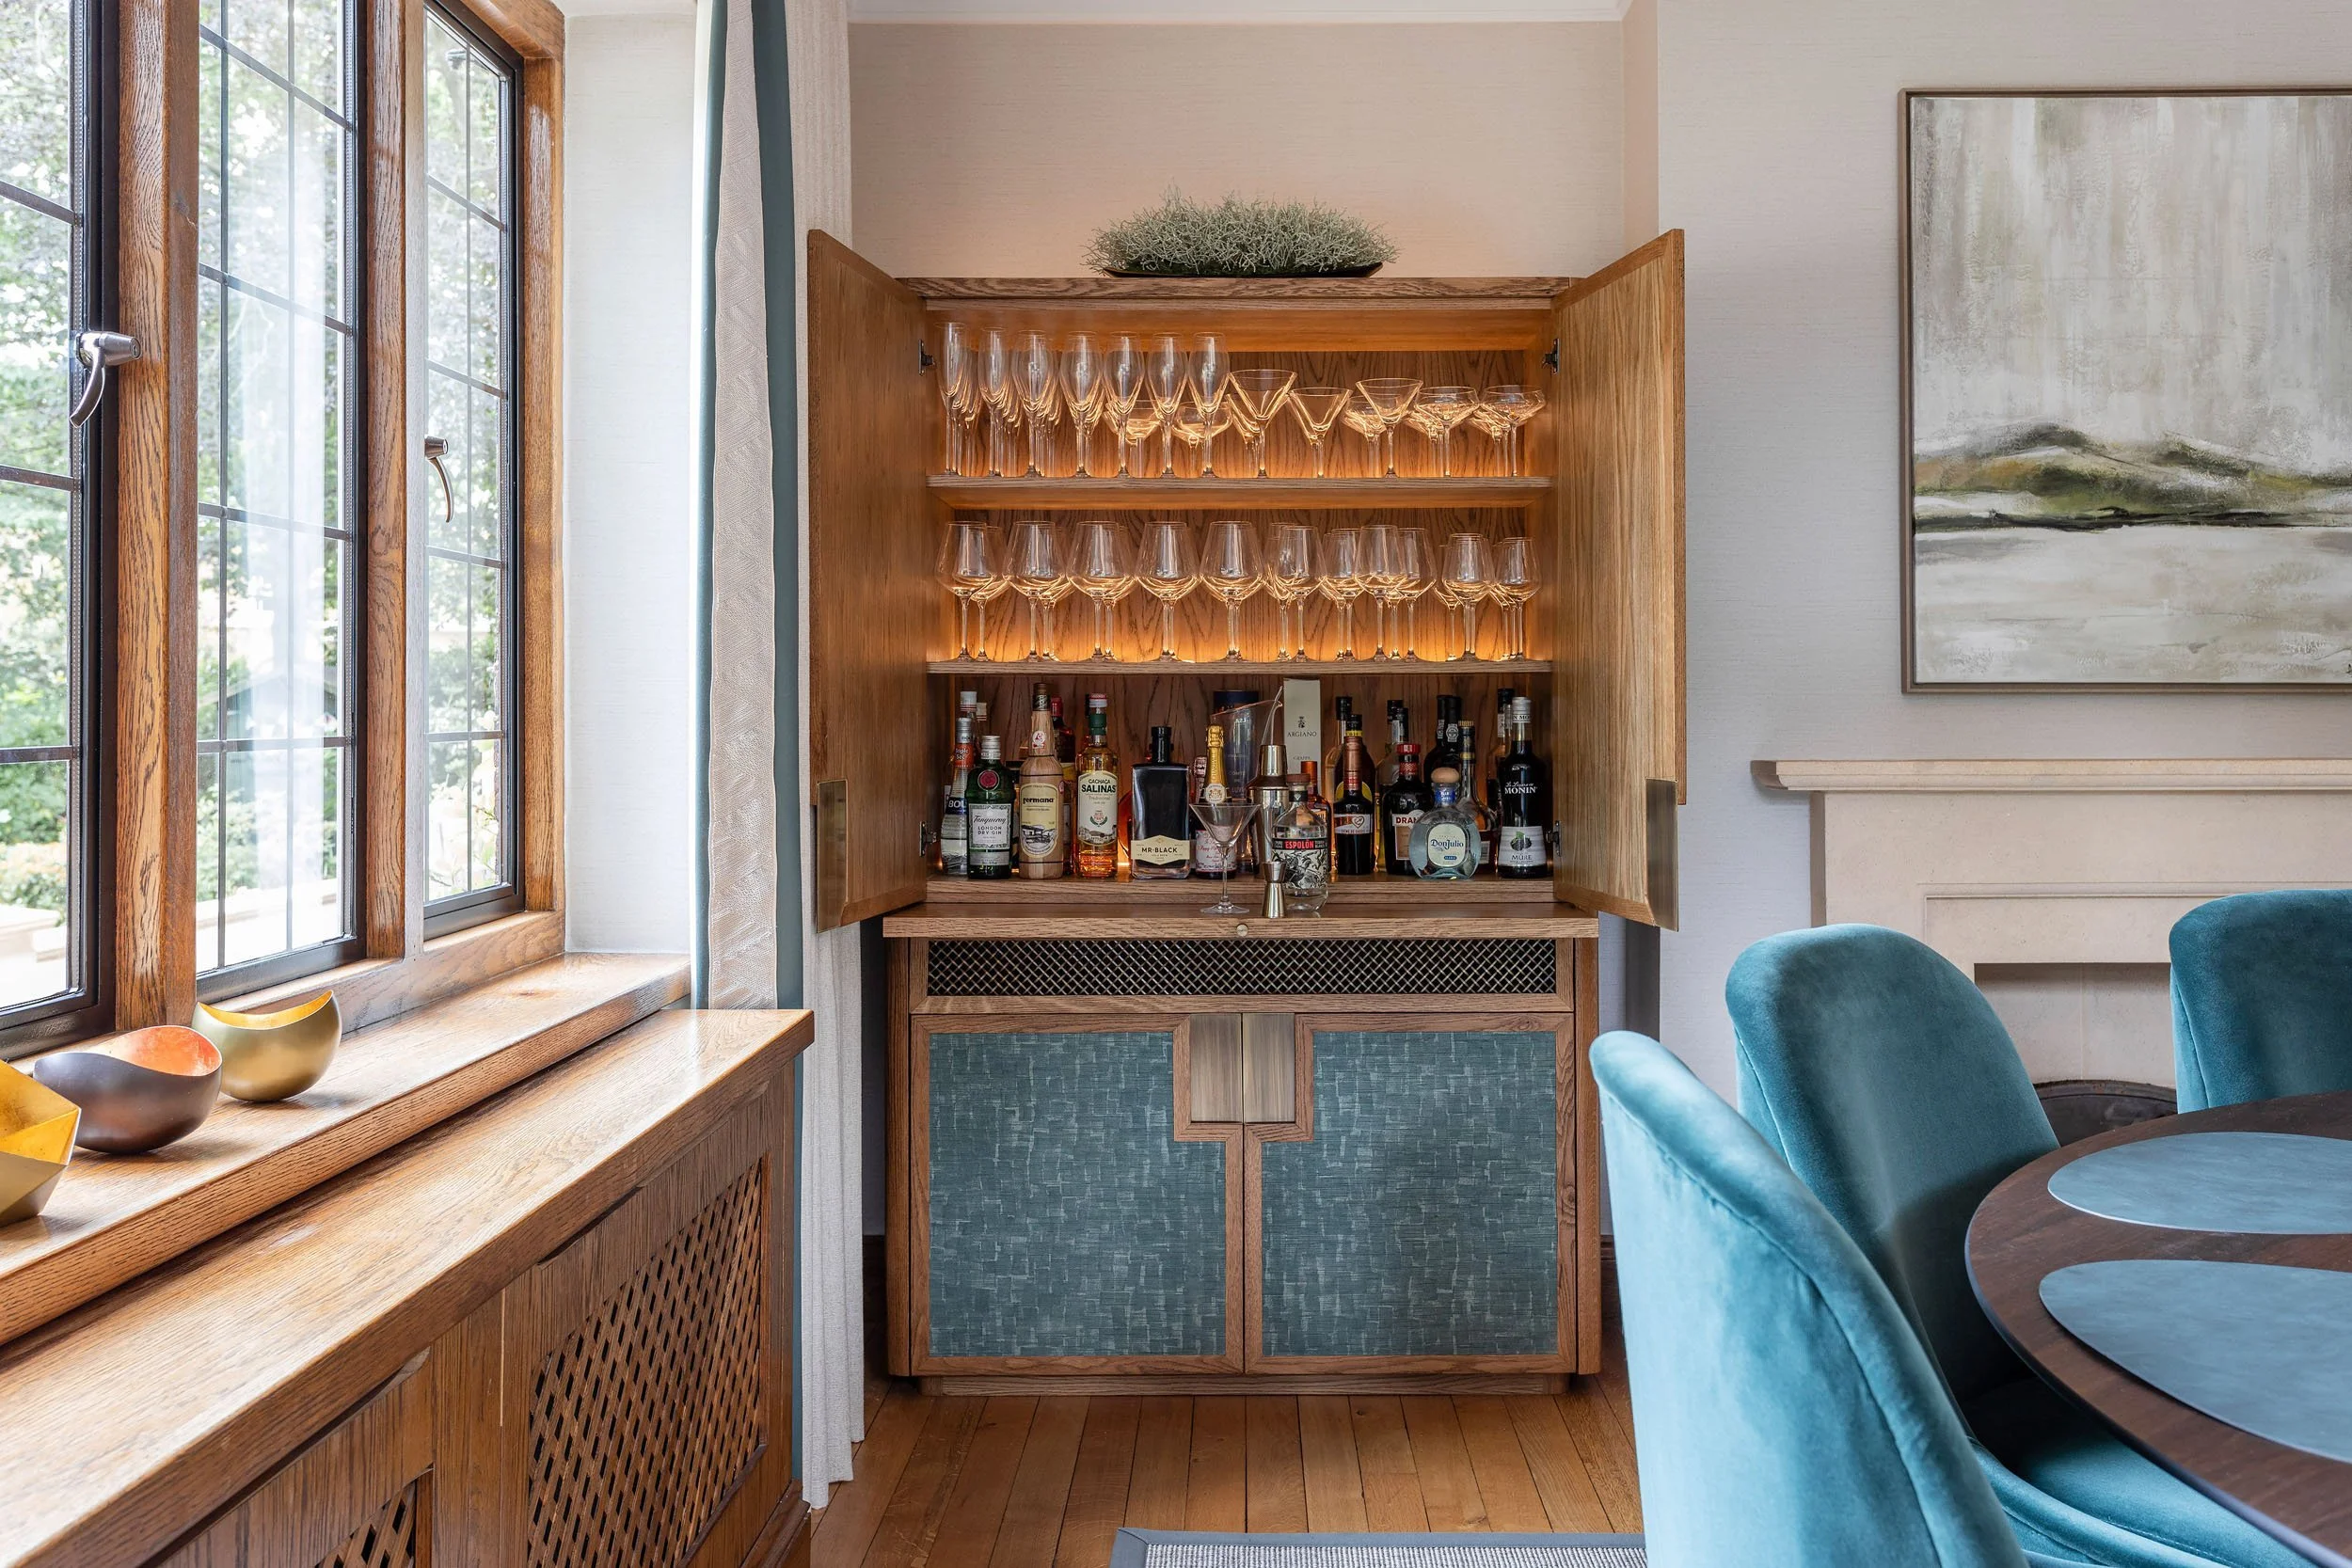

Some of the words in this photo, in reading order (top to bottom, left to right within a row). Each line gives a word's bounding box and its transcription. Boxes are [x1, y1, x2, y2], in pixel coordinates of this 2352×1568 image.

[1081, 784, 1117, 793] SALINAS
[973, 815, 1007, 825] Tanqueray
[1285, 839, 1314, 849] ESPOLÓN
